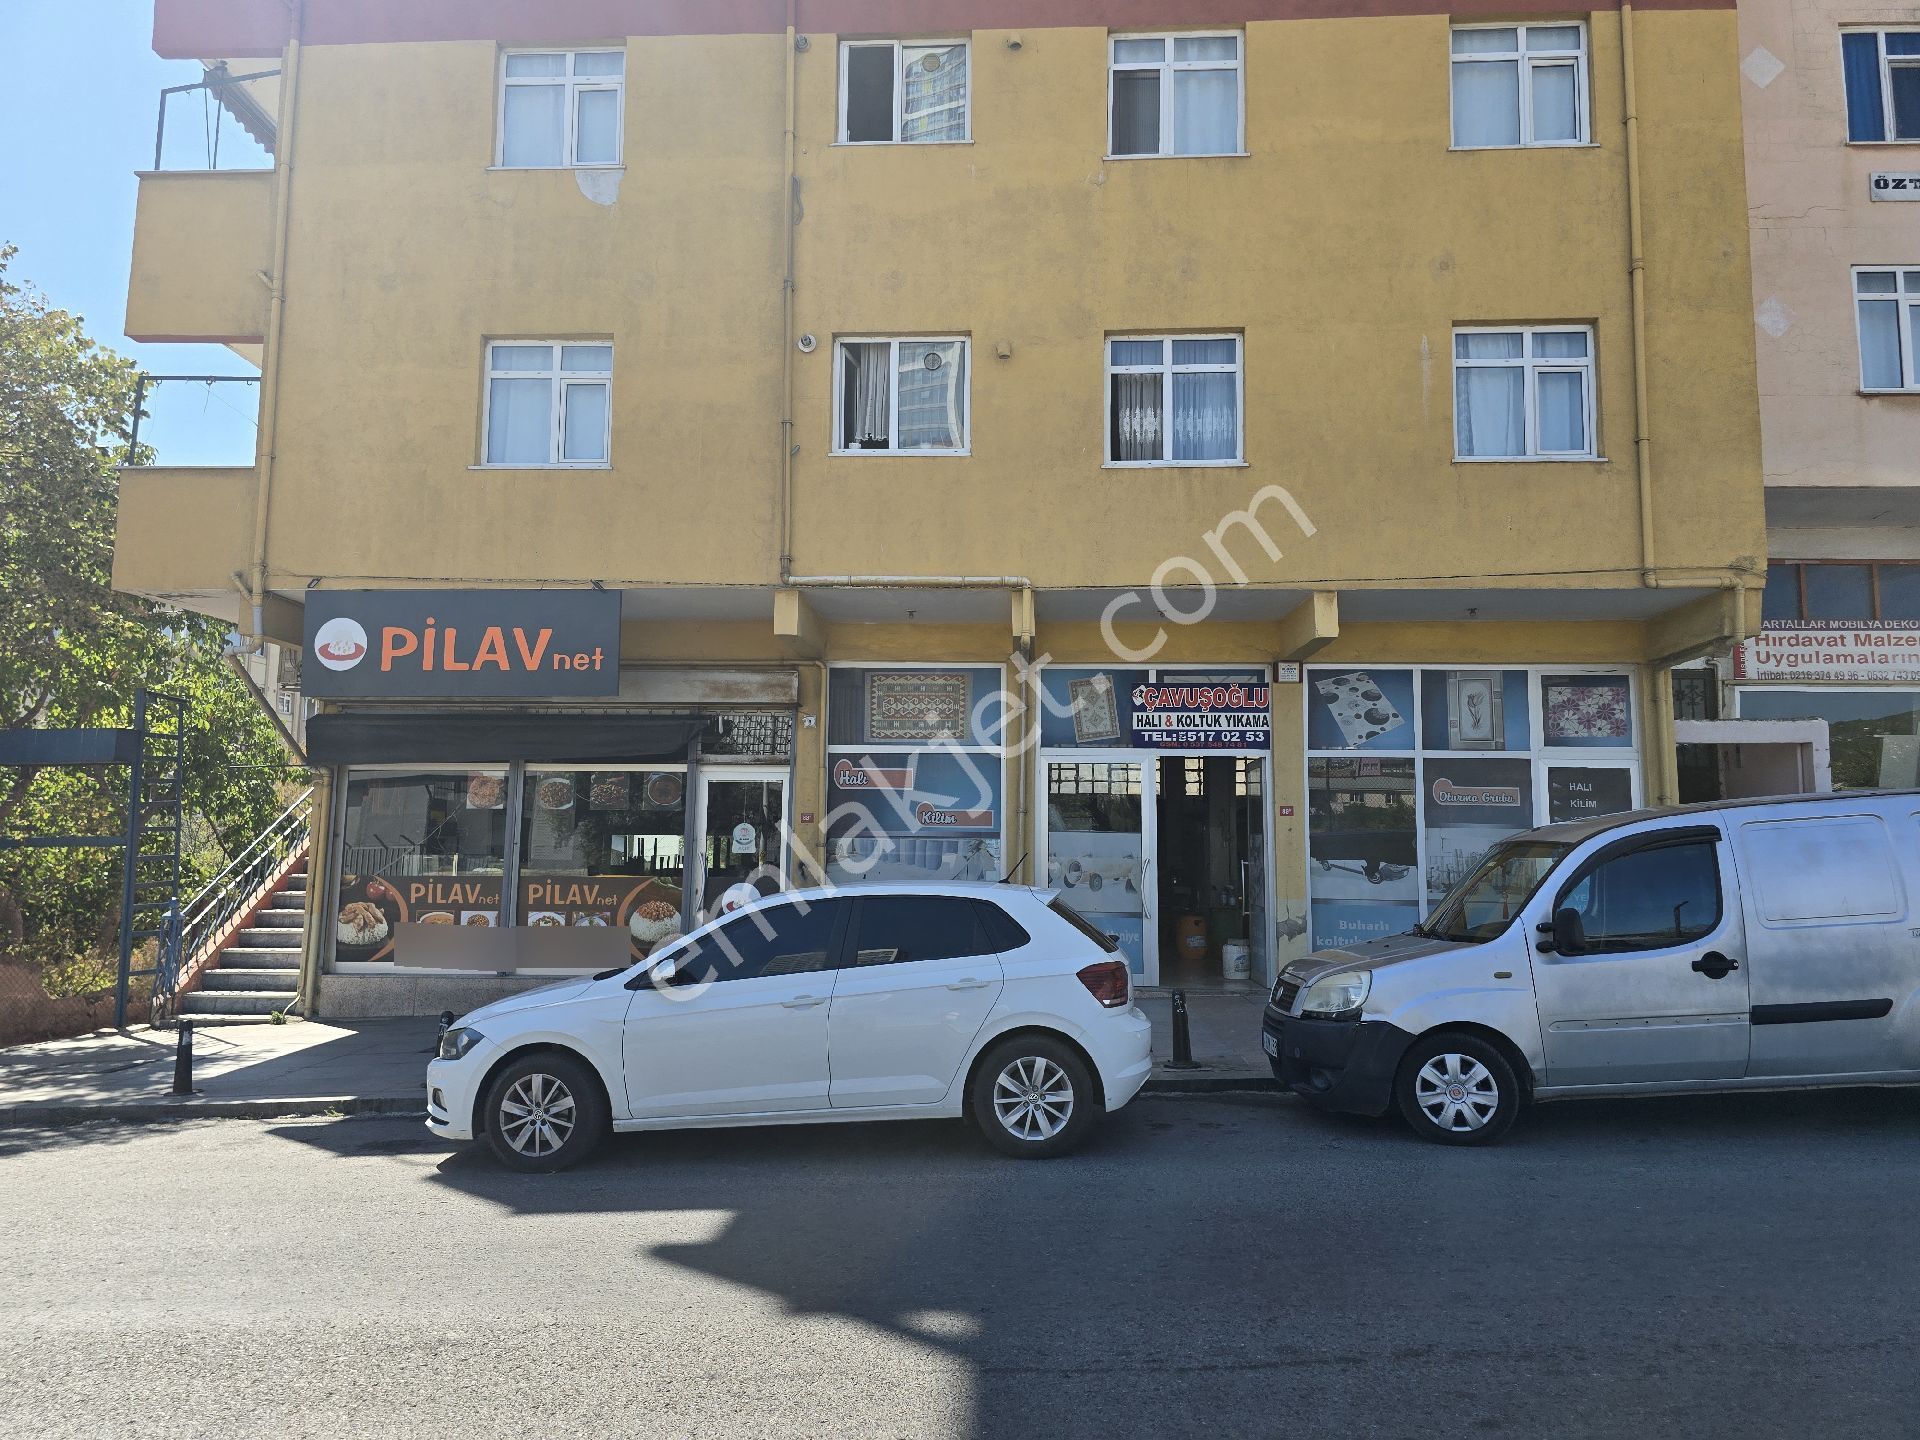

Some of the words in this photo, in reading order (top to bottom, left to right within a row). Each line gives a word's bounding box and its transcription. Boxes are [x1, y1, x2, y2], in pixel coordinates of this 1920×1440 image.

[1760, 620, 1825, 629] ARTALLAR
[1885, 620, 1920, 629] DEKO
[1754, 633, 1847, 648] Hırdavat
[1853, 633, 1920, 647] Malze
[1143, 683, 1269, 713] ÇAVUŞOĞLU
[1136, 714, 1162, 728] HALI
[1165, 714, 1173, 728] &
[1177, 714, 1222, 728] KOLTUK
[1225, 714, 1269, 728] YIKAMA
[1221, 731, 1240, 742] 02
[1245, 731, 1265, 742] 53
[1569, 782, 1592, 792] HALI
[1570, 799, 1597, 809] KİLİM
[921, 811, 957, 825] Kilim
